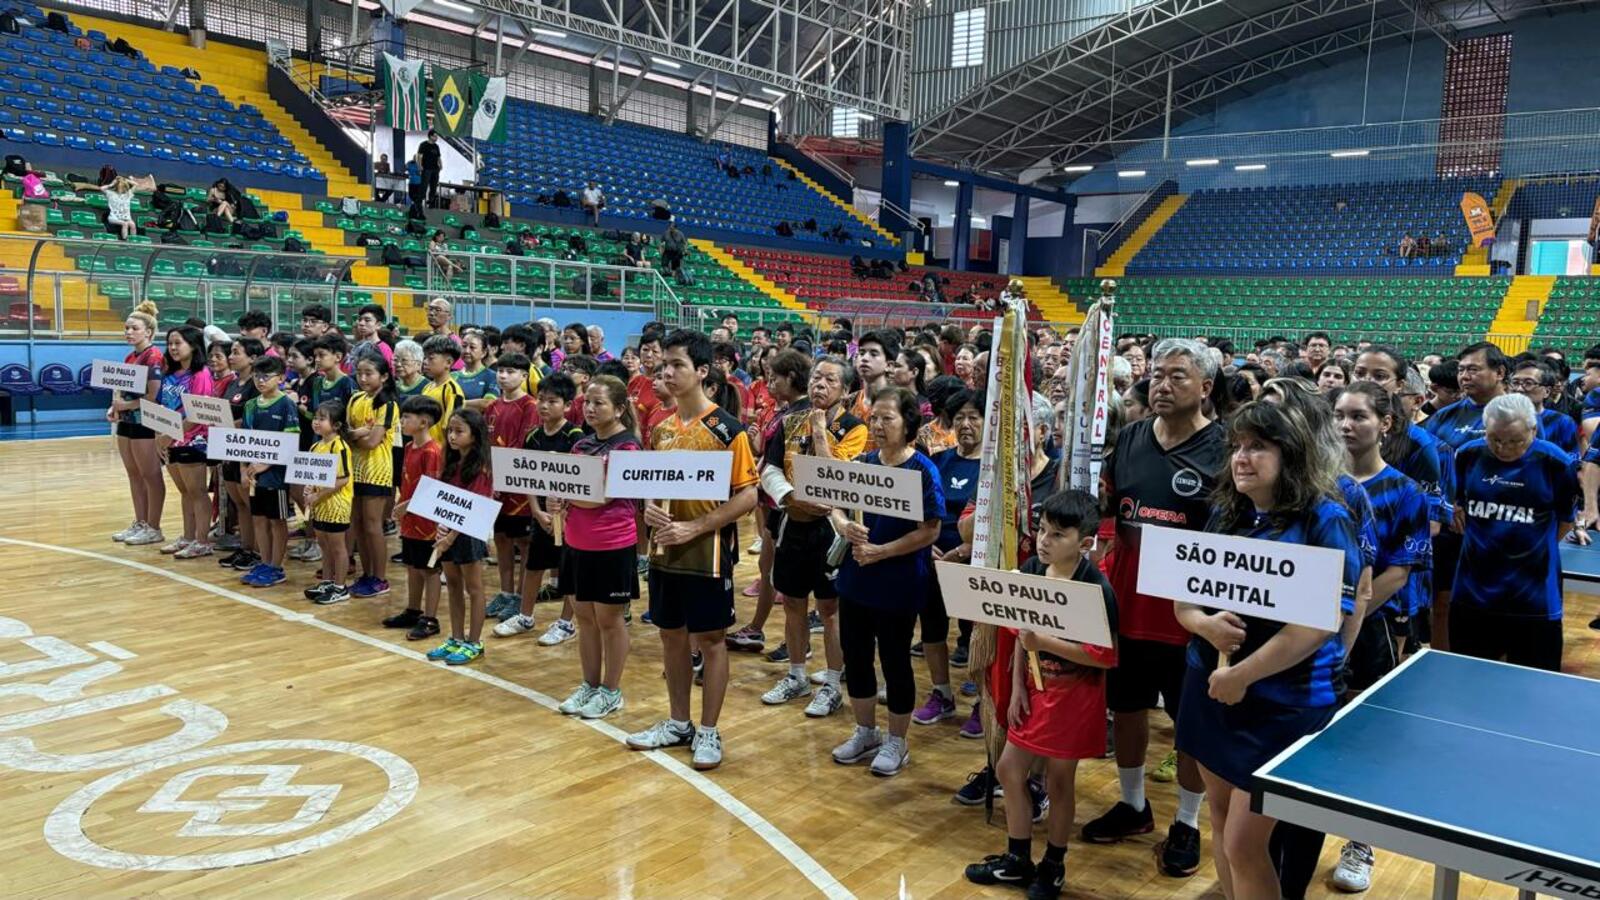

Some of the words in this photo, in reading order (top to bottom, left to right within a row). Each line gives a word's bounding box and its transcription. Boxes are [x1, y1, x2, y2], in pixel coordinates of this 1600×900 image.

[102, 364, 116, 375] SÃO
[115, 367, 137, 377] PAULO
[1095, 319, 1112, 438] CENTRAL
[102, 377, 135, 388] SUDOESTE
[989, 400, 1000, 443] SUL
[225, 433, 246, 445] SÃO
[248, 437, 281, 448] PAULO
[225, 448, 279, 461] NOROESTE
[293, 456, 309, 465] MATO
[309, 458, 333, 468] GROSSO
[294, 470, 303, 478] DO
[303, 472, 315, 480] SUL
[318, 473, 327, 481] MS
[513, 456, 538, 471] SÃO
[541, 461, 581, 476] PAULO
[622, 469, 685, 482] CURITIBA
[696, 470, 715, 482] PR
[505, 475, 546, 491] DUTRA
[550, 481, 591, 496] NORTE
[817, 466, 845, 481] SÃO
[848, 471, 895, 489] PAULO
[436, 489, 473, 511] PARANÁ
[805, 485, 860, 503] CENTRO
[863, 494, 911, 512] OESTE
[433, 506, 466, 526] NORTE
[1139, 506, 1186, 523] OPERA
[1468, 499, 1535, 524] CAPITAL
[1175, 542, 1217, 565] SÃO
[1223, 551, 1296, 577] PAULO
[968, 576, 1004, 594] SÃO
[1009, 583, 1068, 606] PAULO
[1187, 576, 1276, 608] CAPITAL
[981, 601, 1066, 630] CENTRAL
